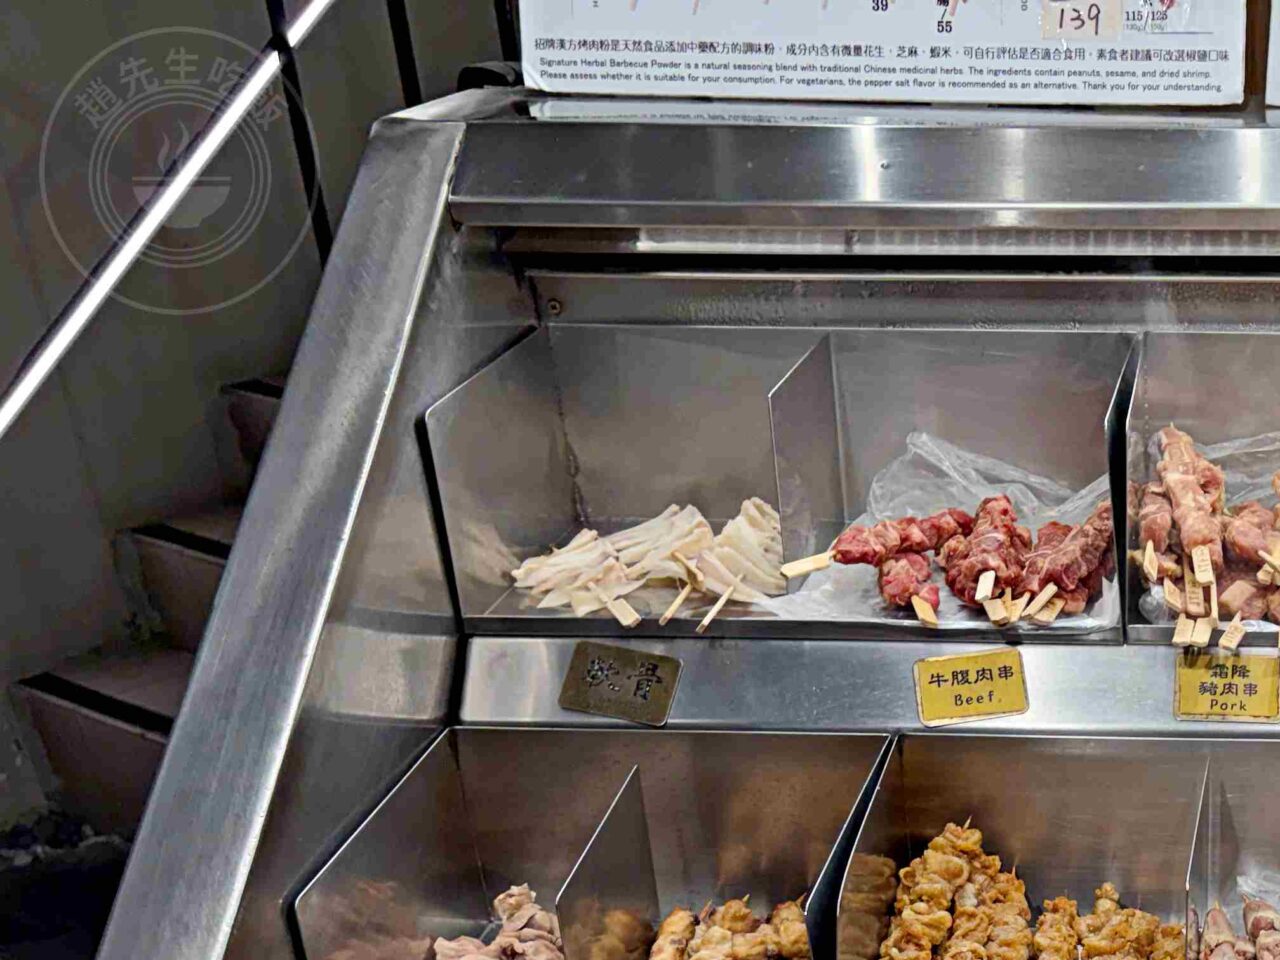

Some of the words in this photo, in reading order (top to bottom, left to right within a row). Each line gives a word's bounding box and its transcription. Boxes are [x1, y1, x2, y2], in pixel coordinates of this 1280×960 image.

[937, 21, 953, 33] 55
[1058, 3, 1101, 36] 139
[539, 57, 578, 68] Signature
[580, 58, 607, 67] Herbal
[609, 59, 648, 68] Barbecue
[651, 59, 682, 69] Powder
[701, 62, 730, 70] natural
[733, 63, 773, 73] seasoning
[775, 63, 797, 72] blend
[800, 64, 818, 72] with
[820, 64, 861, 73] traditional
[864, 65, 897, 73] Chinese
[899, 66, 937, 74] medicinal
[968, 67, 984, 75] The
[986, 67, 1031, 77] ingredients
[1034, 68, 1065, 77] contain
[1159, 70, 1180, 78] dried
[540, 70, 567, 79] Please
[600, 72, 633, 81] whether
[654, 73, 685, 81] suitable
[687, 73, 699, 81] for
[702, 75, 720, 83] your
[779, 76, 793, 84] For
[848, 78, 862, 86] the
[864, 79, 893, 88] pepper
[895, 79, 910, 87] salt
[912, 79, 935, 87] flavor
[949, 80, 1006, 89] recommended
[1082, 81, 1107, 90] Thank
[1110, 83, 1125, 92] you
[1127, 81, 1140, 90] for
[1142, 83, 1160, 92] your
[928, 664, 1014, 688] 牛腹肉串
[954, 690, 994, 706] Beef
[1198, 681, 1258, 697] 豬肉串
[1210, 699, 1247, 711] Pork
